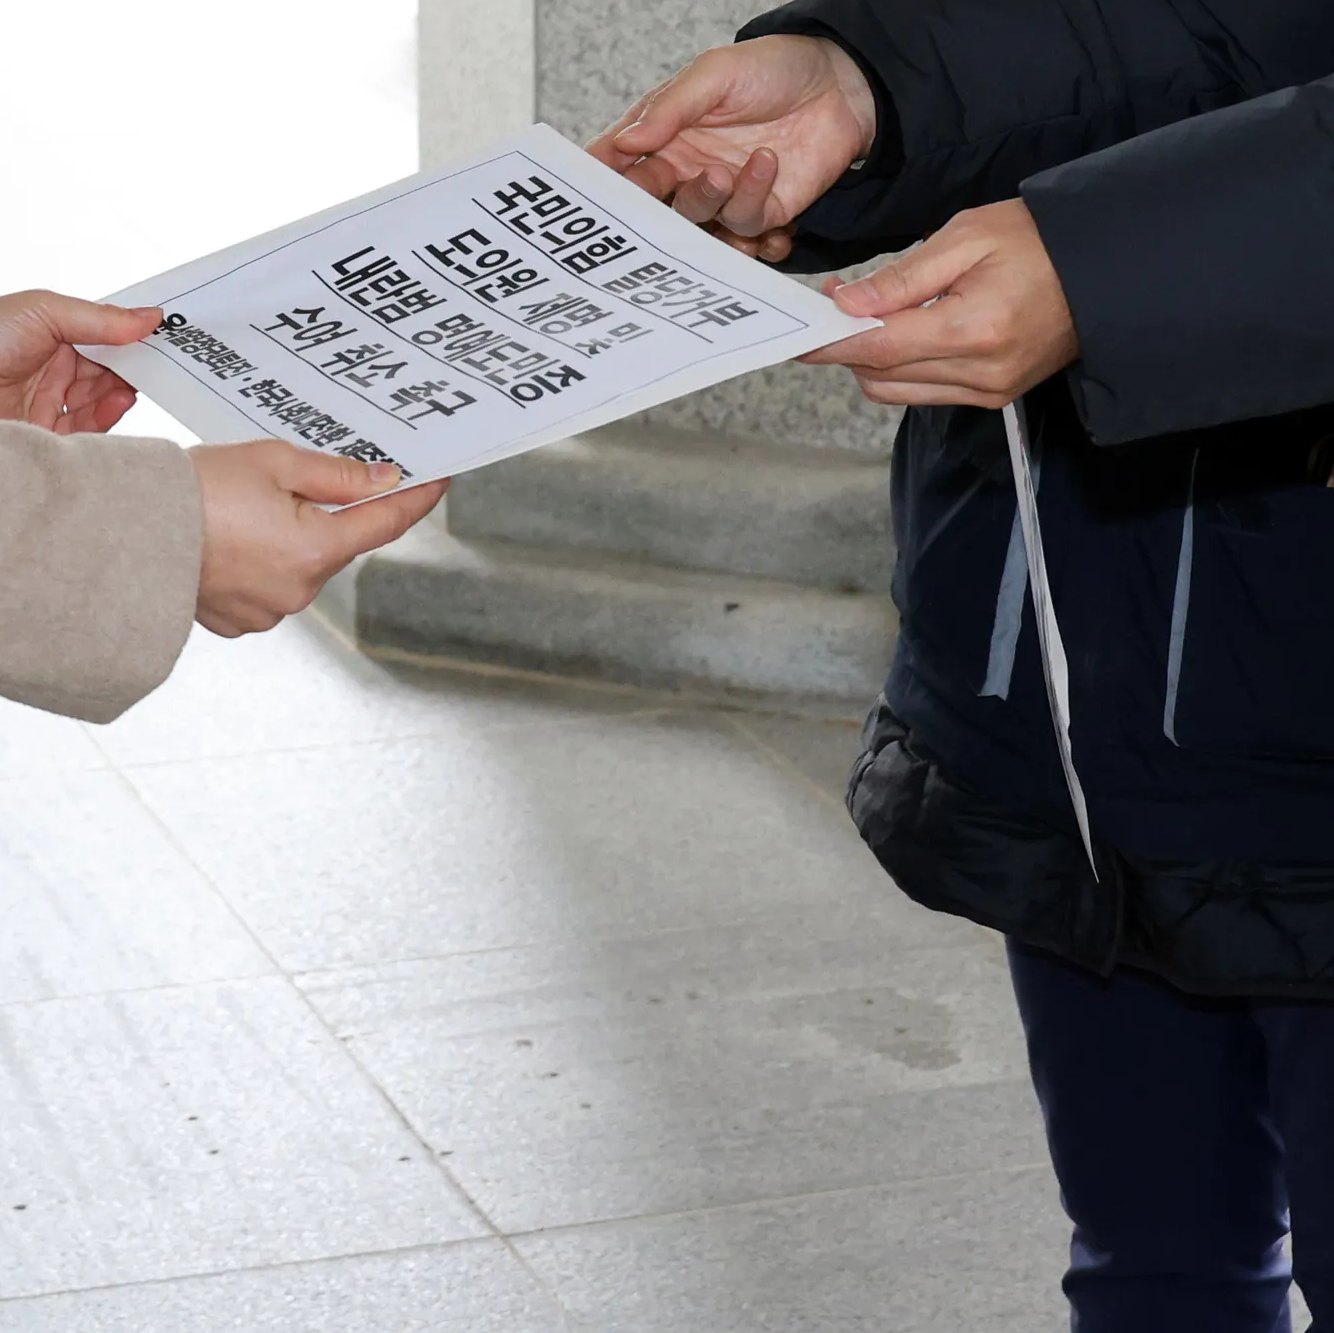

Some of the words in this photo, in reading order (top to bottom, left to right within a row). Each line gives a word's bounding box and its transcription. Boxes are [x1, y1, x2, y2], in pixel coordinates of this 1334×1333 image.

[424, 228, 550, 303] 도의원
[518, 293, 614, 334] 제명
[575, 322, 653, 355] 및
[493, 176, 638, 275] 국민의힘
[601, 260, 759, 328] 탈당거부
[264, 307, 358, 352] 수여
[320, 343, 408, 388] 취소
[389, 380, 477, 421] 촉구
[331, 246, 448, 324] 내란범
[411, 313, 587, 401] 명예도민증
